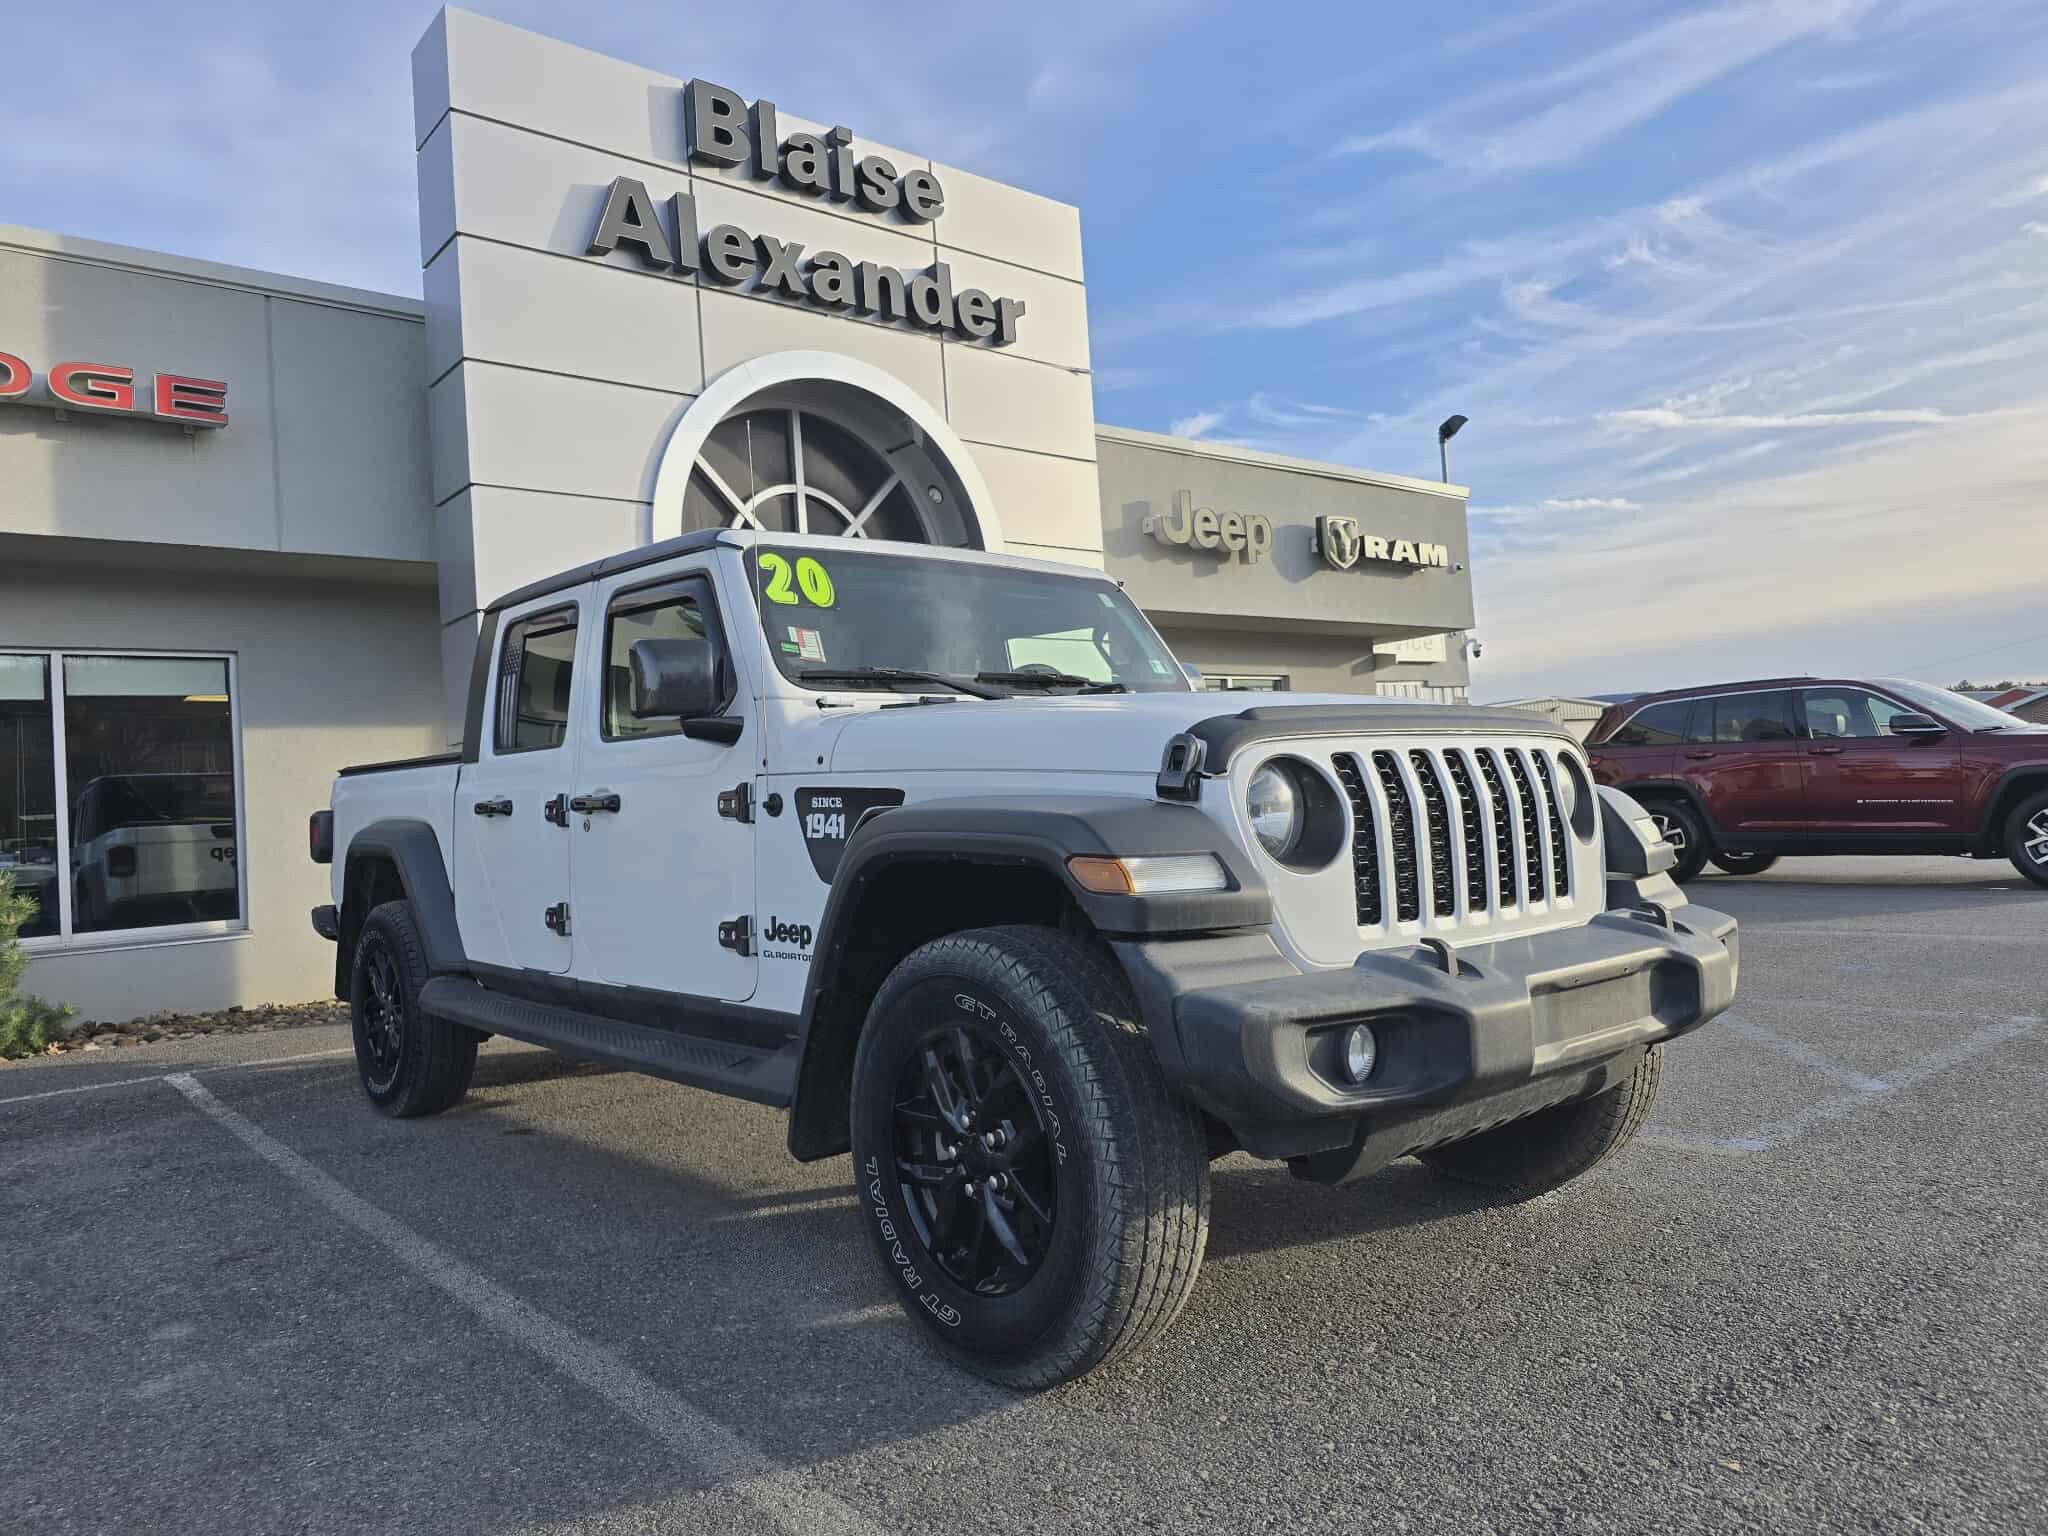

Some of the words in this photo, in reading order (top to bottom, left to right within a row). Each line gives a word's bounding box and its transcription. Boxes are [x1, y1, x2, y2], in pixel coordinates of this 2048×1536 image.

[684, 77, 945, 224] Blaise
[585, 175, 1026, 347] Alexander
[1151, 489, 1272, 564] Jeep
[1360, 534, 1449, 567] RAM
[758, 553, 836, 608] 20
[806, 813, 846, 839] 1941
[811, 797, 843, 809] SINCE
[764, 915, 812, 950] Jeep
[954, 993, 997, 1020] GT
[1000, 1021, 1067, 1166] RADIAL
[865, 1156, 923, 1289] RADIAL
[920, 1293, 961, 1327] GT
